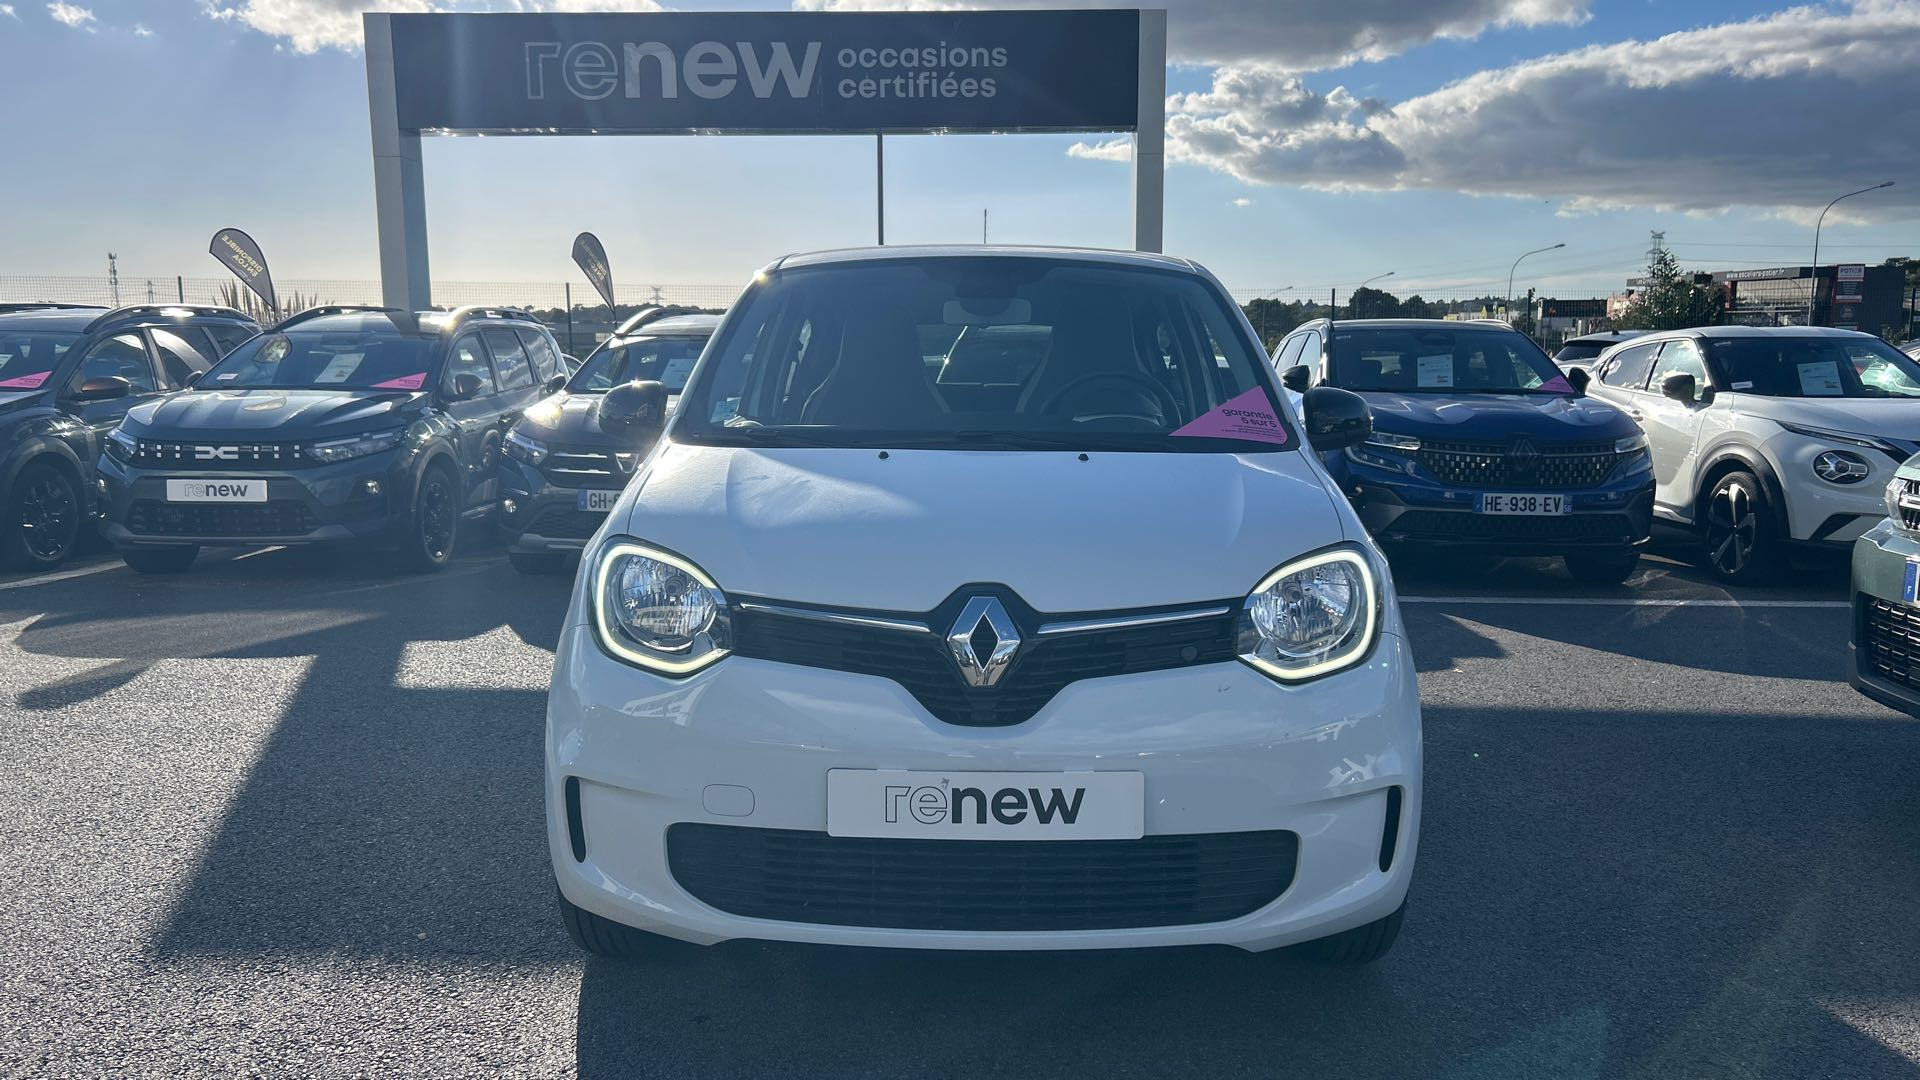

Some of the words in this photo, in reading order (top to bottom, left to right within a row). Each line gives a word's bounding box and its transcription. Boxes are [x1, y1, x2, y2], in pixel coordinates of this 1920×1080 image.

[837, 41, 1008, 68] occasions
[522, 40, 823, 100] renew
[837, 71, 997, 99] certifiées
[1222, 408, 1273, 420] garantie
[1250, 418, 1268, 426] sur
[1270, 420, 1277, 428] 5
[184, 484, 248, 497] renew
[1484, 496, 1561, 512] HE-938-EV
[885, 785, 1086, 825] renew
